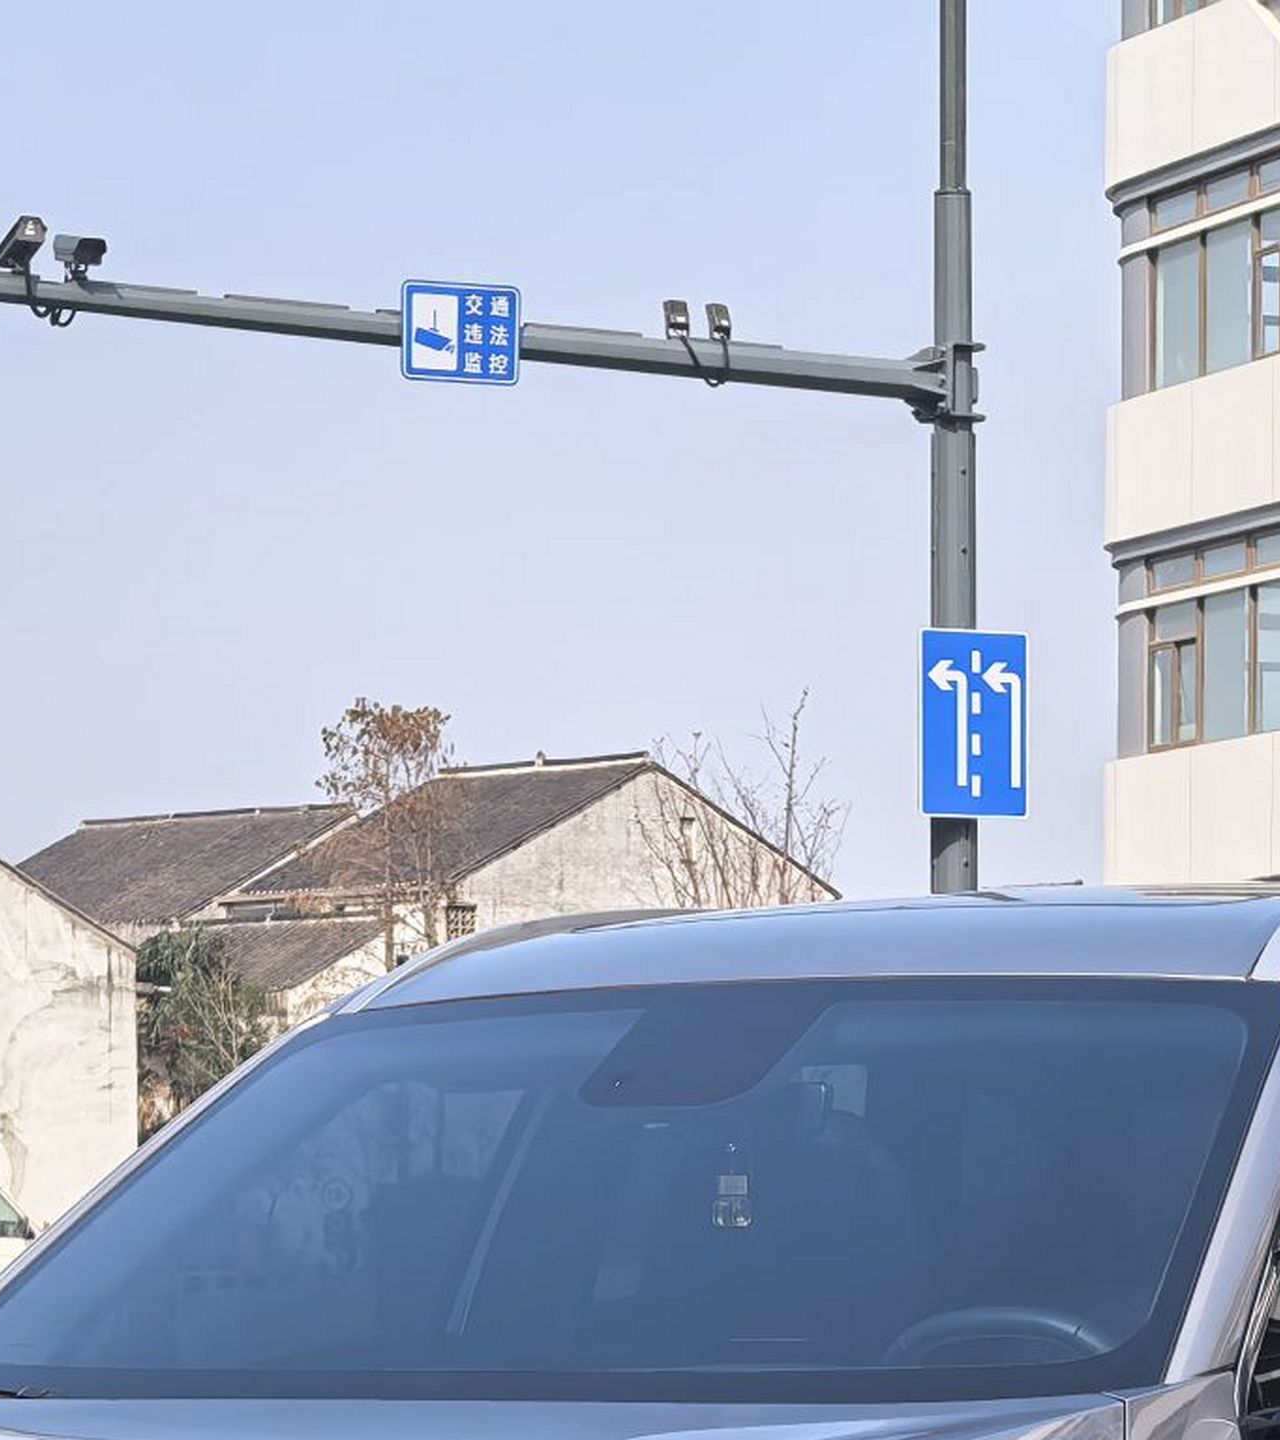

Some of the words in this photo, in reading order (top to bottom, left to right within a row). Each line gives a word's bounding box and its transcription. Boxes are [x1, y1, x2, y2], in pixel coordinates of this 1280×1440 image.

[464, 294, 509, 318] 交通
[463, 323, 509, 346] 违法
[463, 352, 508, 374] 监控
